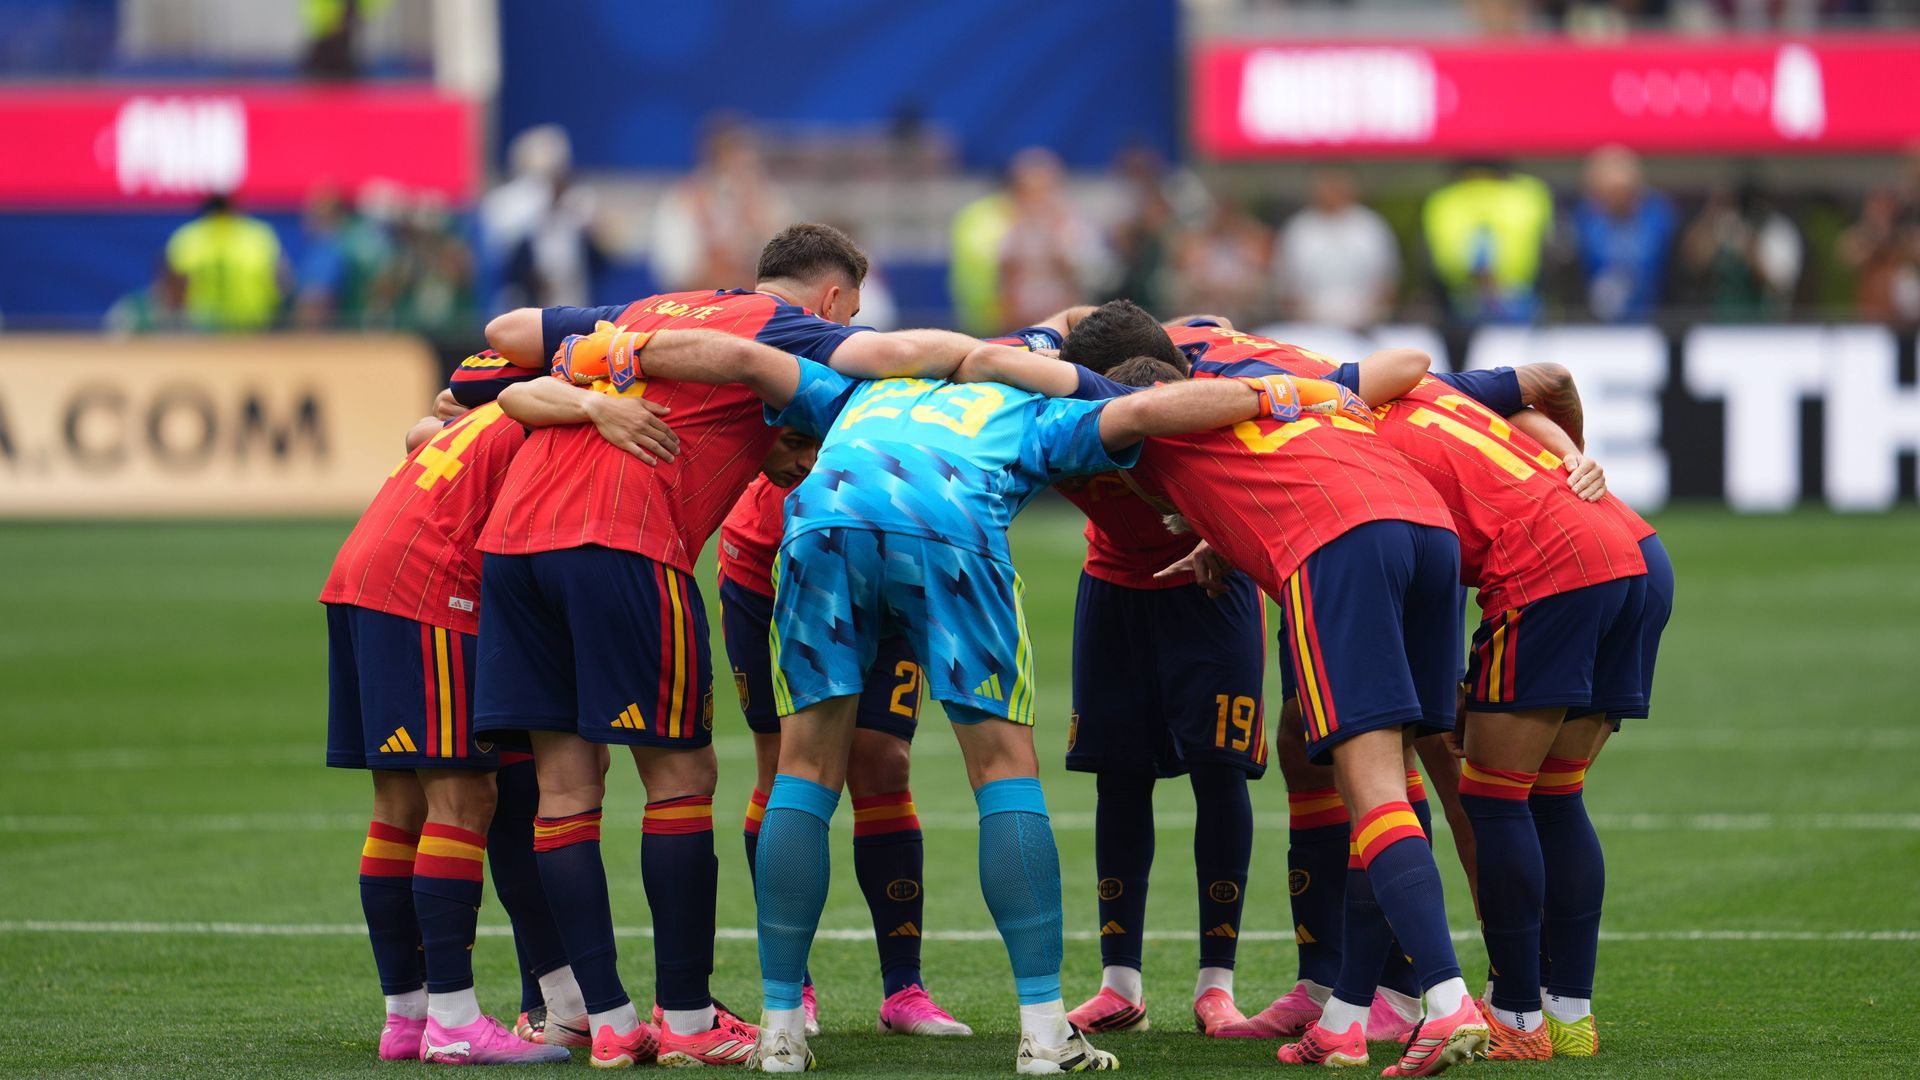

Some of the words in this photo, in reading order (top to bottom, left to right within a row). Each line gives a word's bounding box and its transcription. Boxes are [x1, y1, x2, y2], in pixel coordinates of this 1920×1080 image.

[0, 378, 333, 474] .COM
[840, 378, 1005, 438] 23
[389, 401, 504, 491] 4
[1215, 694, 1256, 752] 19
